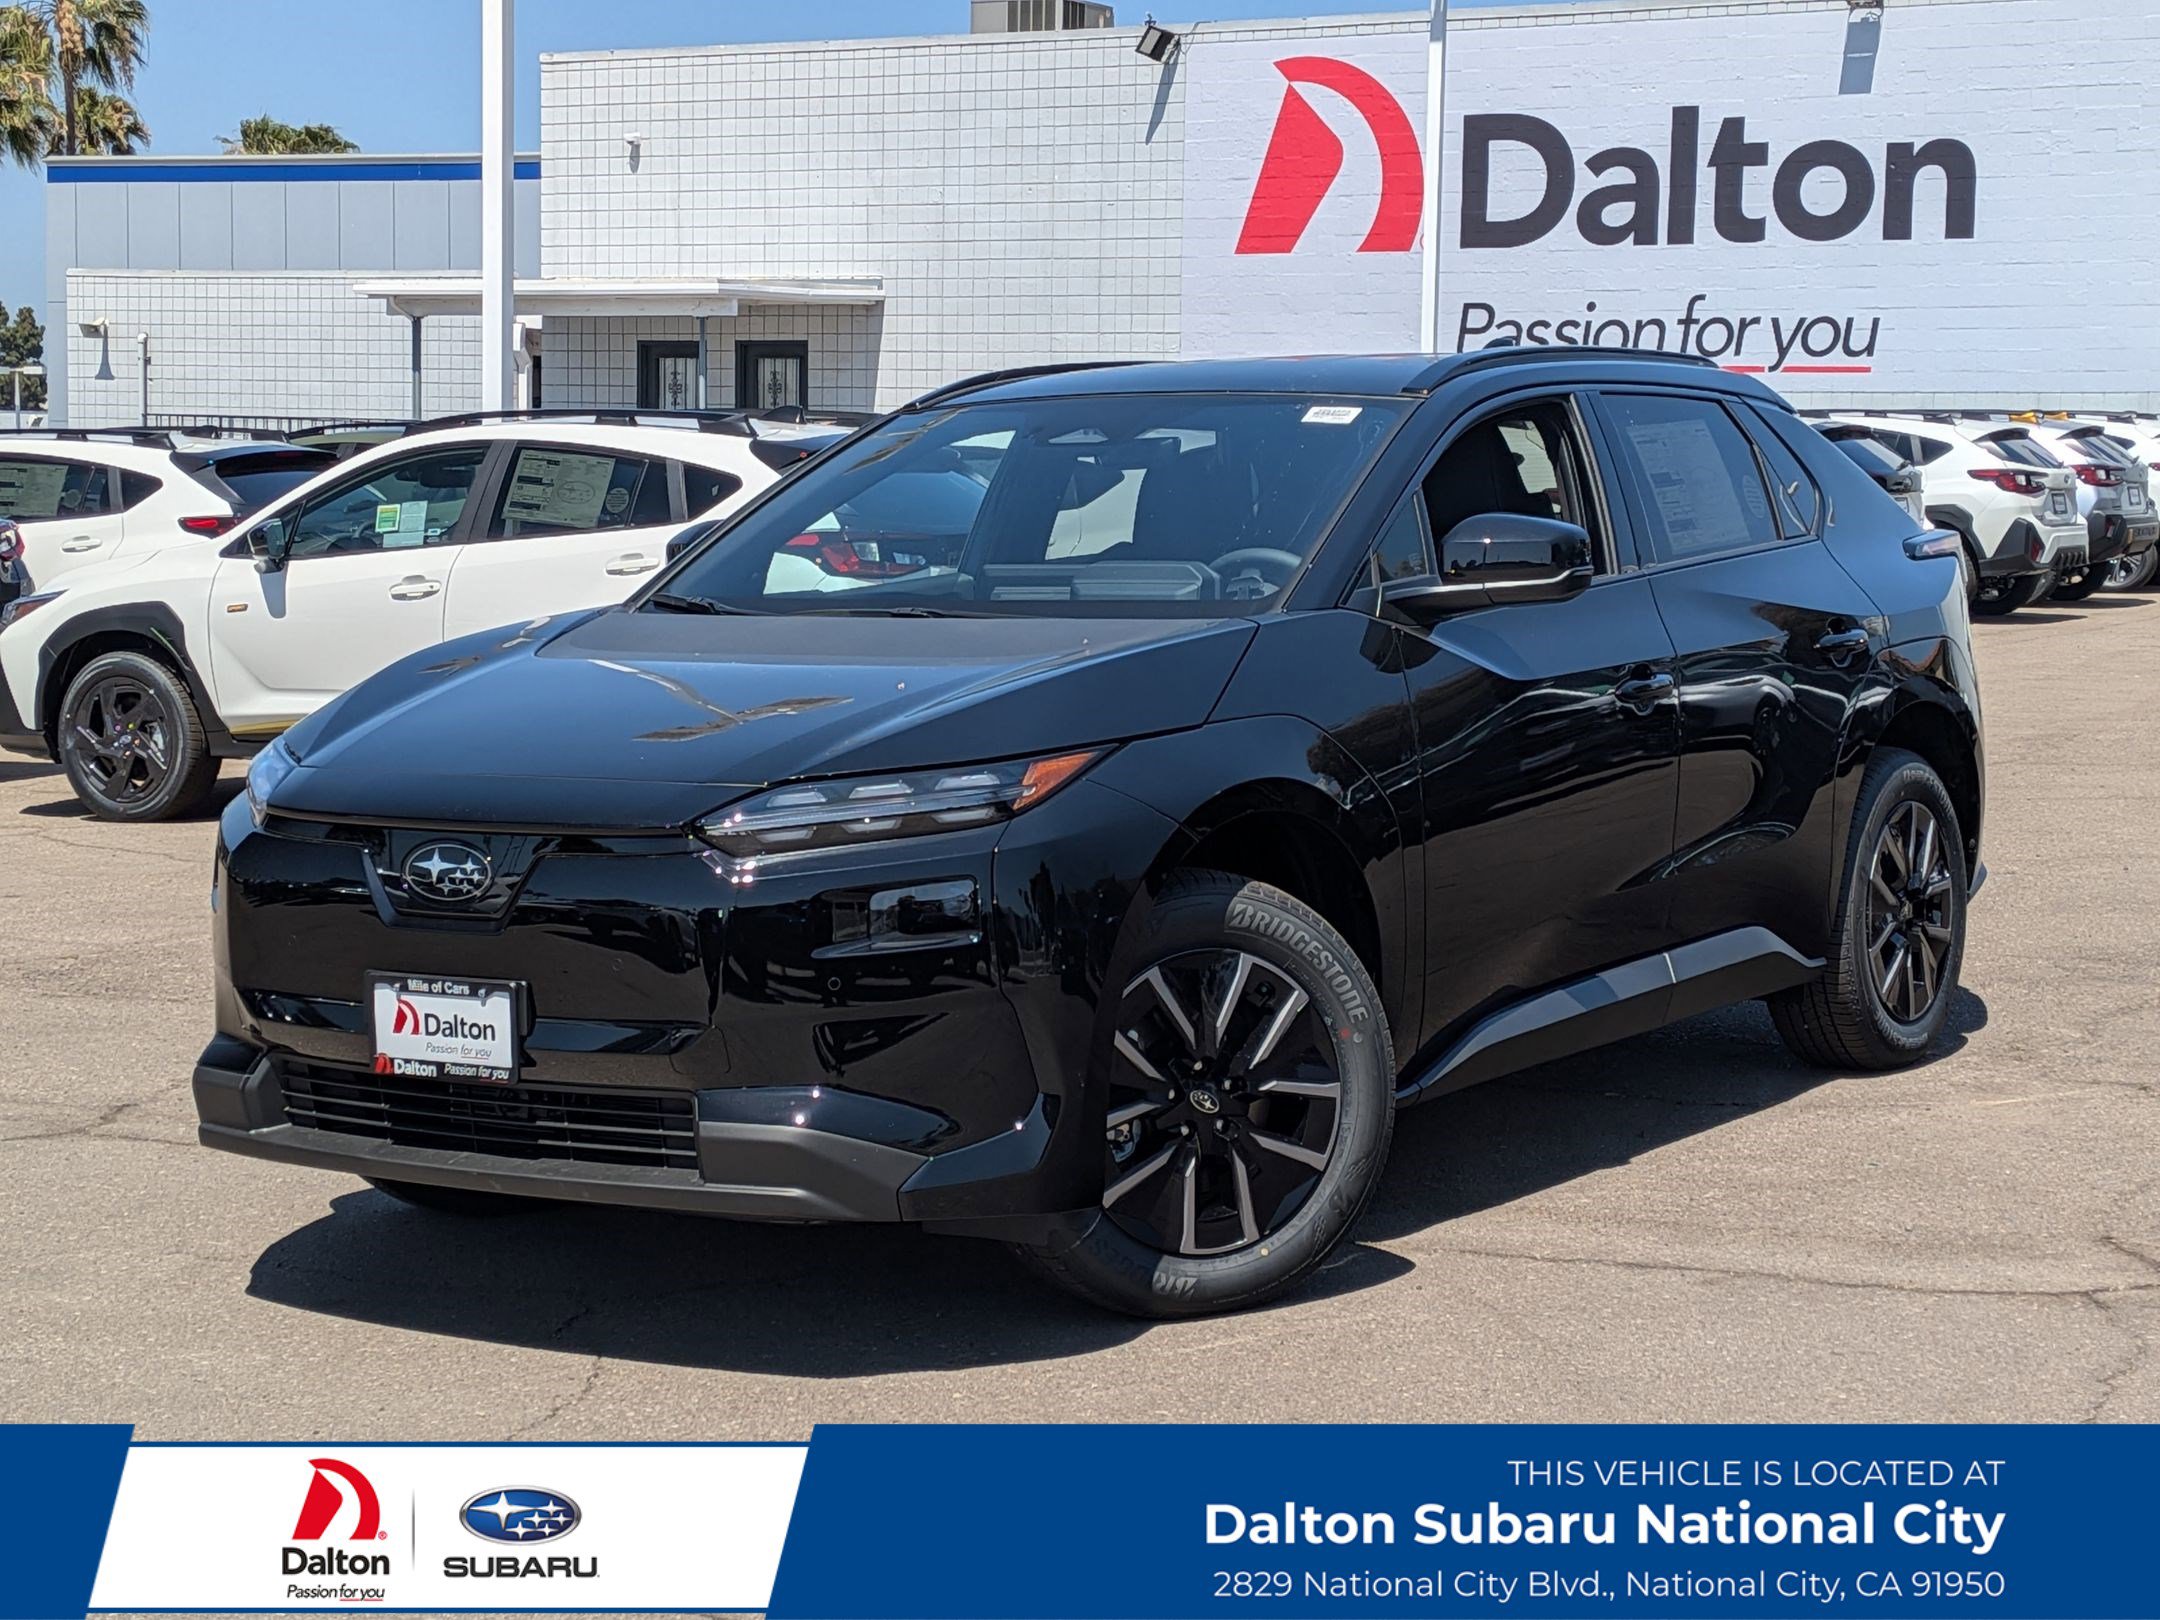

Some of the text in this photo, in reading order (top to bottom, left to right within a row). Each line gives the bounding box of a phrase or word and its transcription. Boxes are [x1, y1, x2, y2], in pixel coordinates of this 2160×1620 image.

[1460, 106, 1976, 248] Dalton
[1677, 294, 1761, 357] for
[1768, 316, 1880, 372] you
[1229, 903, 1368, 1024] BRIDGESTONE
[407, 978, 470, 995] Mile of Cars
[424, 1013, 496, 1041] Dalton
[425, 1042, 492, 1058] Passion for you
[394, 1059, 509, 1080] Dalton Passion for you
